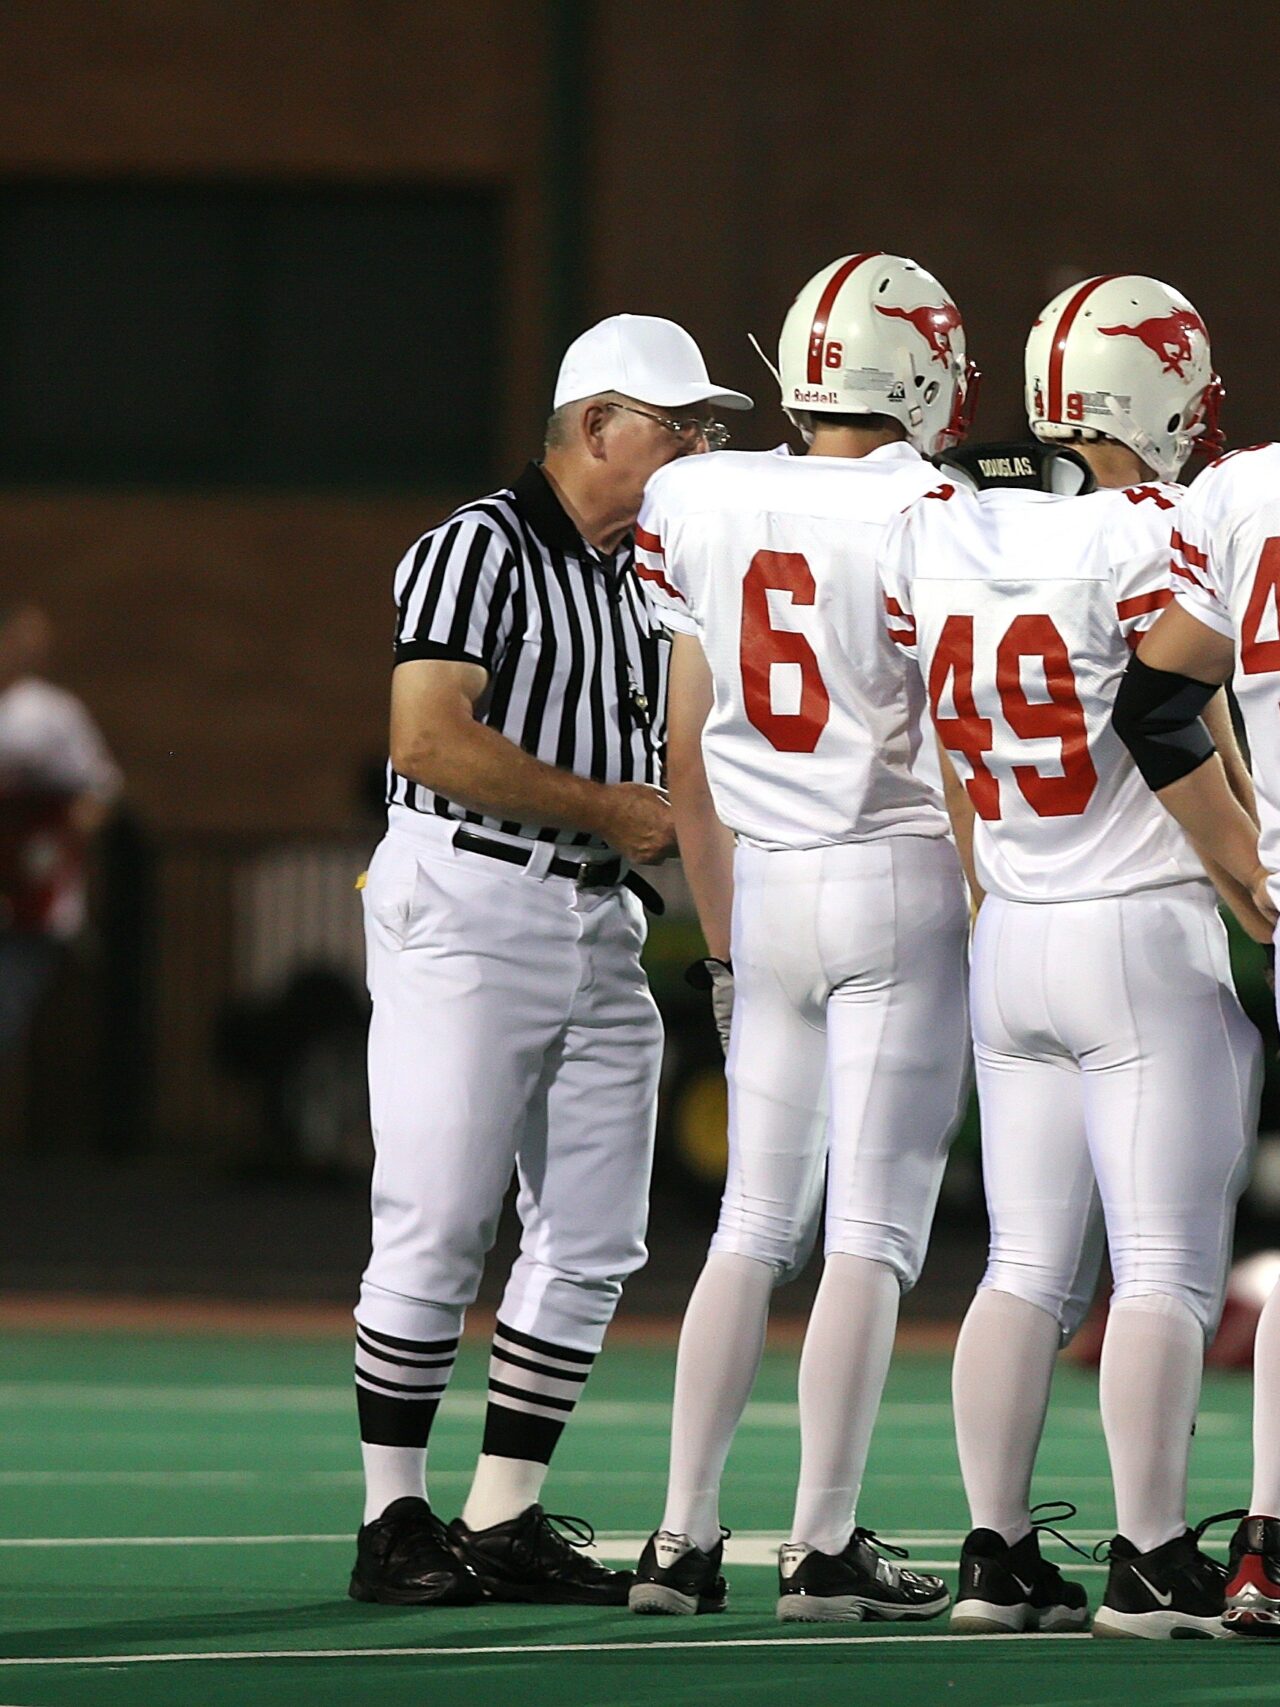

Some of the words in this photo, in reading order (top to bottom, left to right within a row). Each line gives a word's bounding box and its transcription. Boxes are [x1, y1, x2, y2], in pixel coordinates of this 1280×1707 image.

[824, 341, 842, 369] 6
[740, 549, 830, 753] 6
[929, 614, 1098, 821] 49
